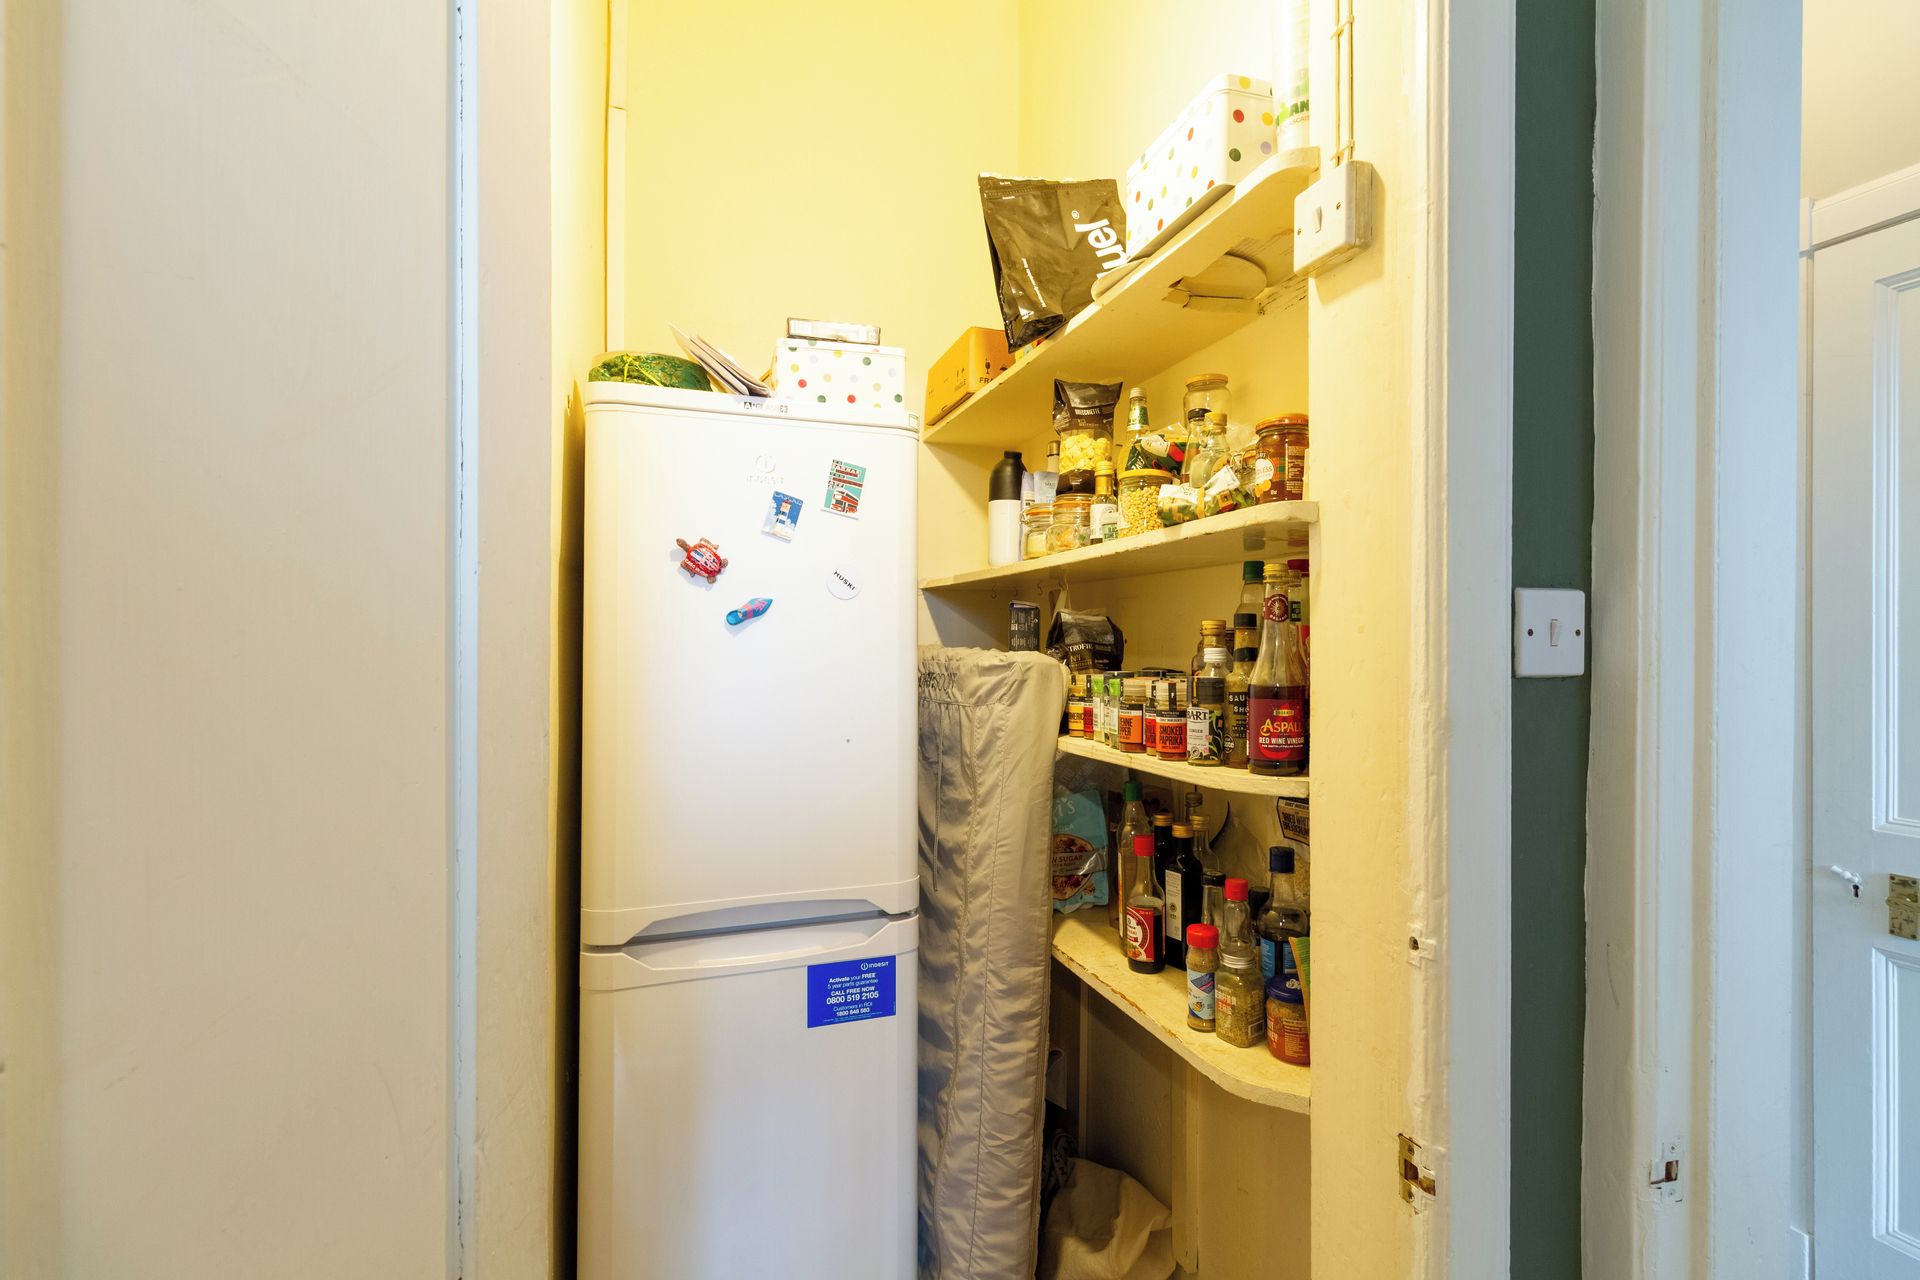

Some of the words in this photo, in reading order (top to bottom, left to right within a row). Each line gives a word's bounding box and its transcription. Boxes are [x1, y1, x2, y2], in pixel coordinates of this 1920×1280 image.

[1074, 218, 1128, 279] uel
[834, 571, 855, 590] HUSKI
[1187, 711, 1208, 720] BART
[1160, 726, 1183, 735] SMOKED
[1160, 736, 1183, 746] PAPRIKA
[1059, 855, 1083, 863] SUGAR
[842, 981, 855, 989] parts
[855, 978, 878, 987] guarantee
[826, 996, 845, 1004] 0800
[846, 994, 860, 1002] 519
[861, 991, 879, 1000] 2105
[833, 1004, 858, 1012] Customers
